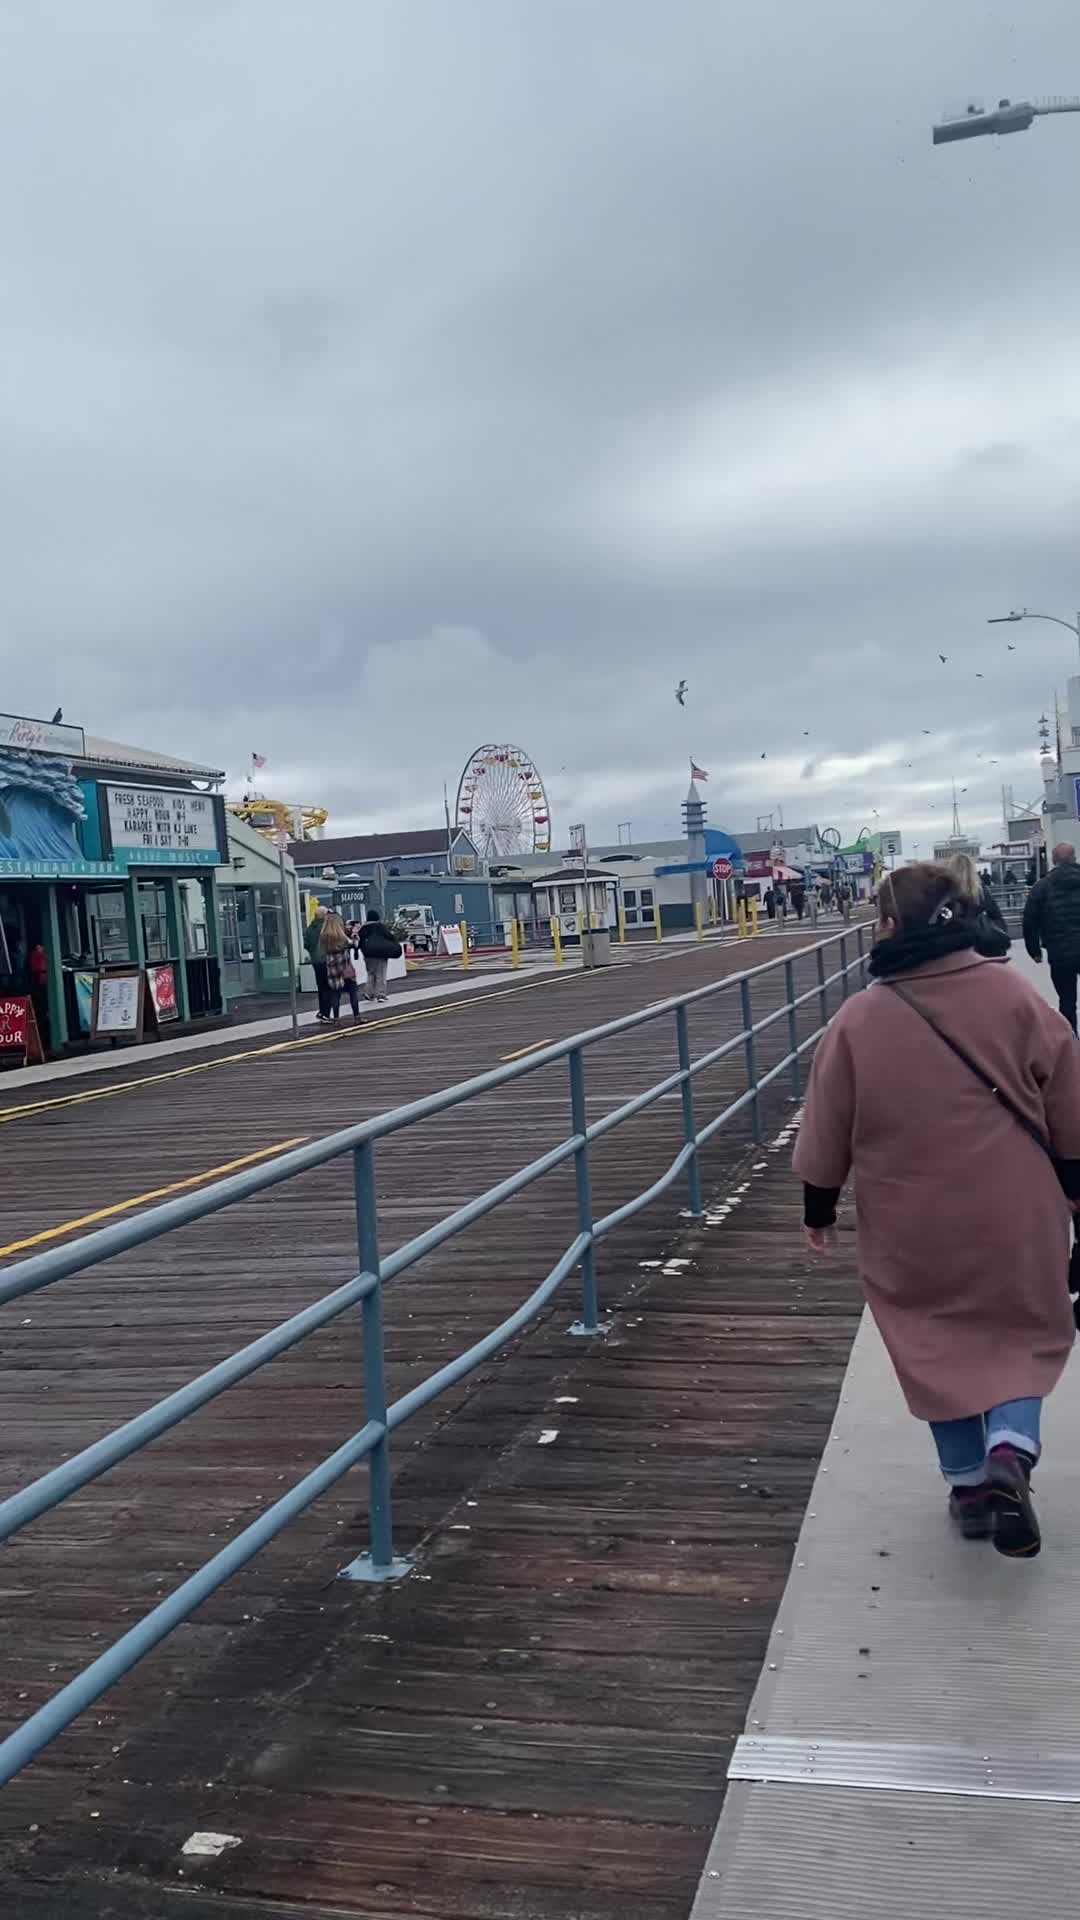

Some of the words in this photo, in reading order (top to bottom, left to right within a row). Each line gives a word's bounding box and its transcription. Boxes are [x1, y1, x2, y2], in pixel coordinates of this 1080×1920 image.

[114, 792, 135, 806] FRESH
[136, 794, 164, 809] SEAFOOD
[172, 799, 186, 810] KIDS
[127, 807, 149, 819] HAPPY
[154, 808, 170, 820] HOUR
[124, 820, 152, 832] KARAOKE
[156, 822, 171, 833] WITH
[142, 833, 153, 846] FRI
[160, 834, 172, 846] SAT
[887, 843, 897, 854] 5
[168, 851, 203, 863] MUSIC
[89, 862, 113, 873] BAR
[714, 863, 731, 873] STOP
[340, 892, 365, 901] SEAFOOD
